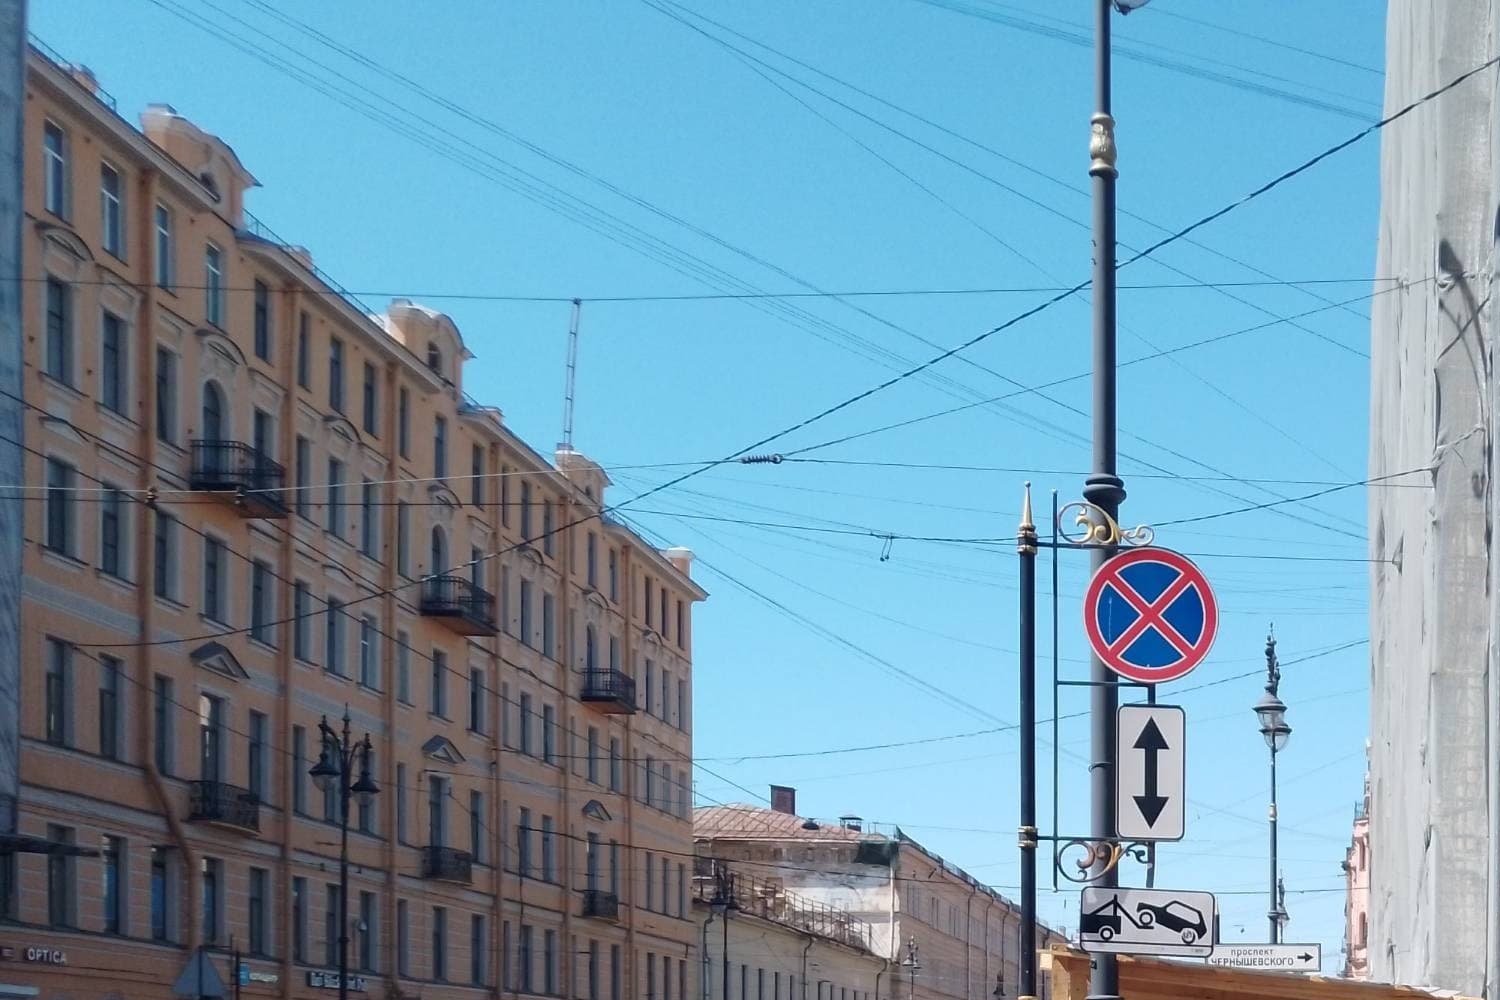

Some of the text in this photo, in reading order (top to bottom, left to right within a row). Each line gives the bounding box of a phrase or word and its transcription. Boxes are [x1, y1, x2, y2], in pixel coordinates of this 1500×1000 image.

[27, 947, 67, 964] OPTICA
[1230, 948, 1274, 957] проспект
[1211, 957, 1294, 967] ЧЕРНЫШЕВСКОГО
